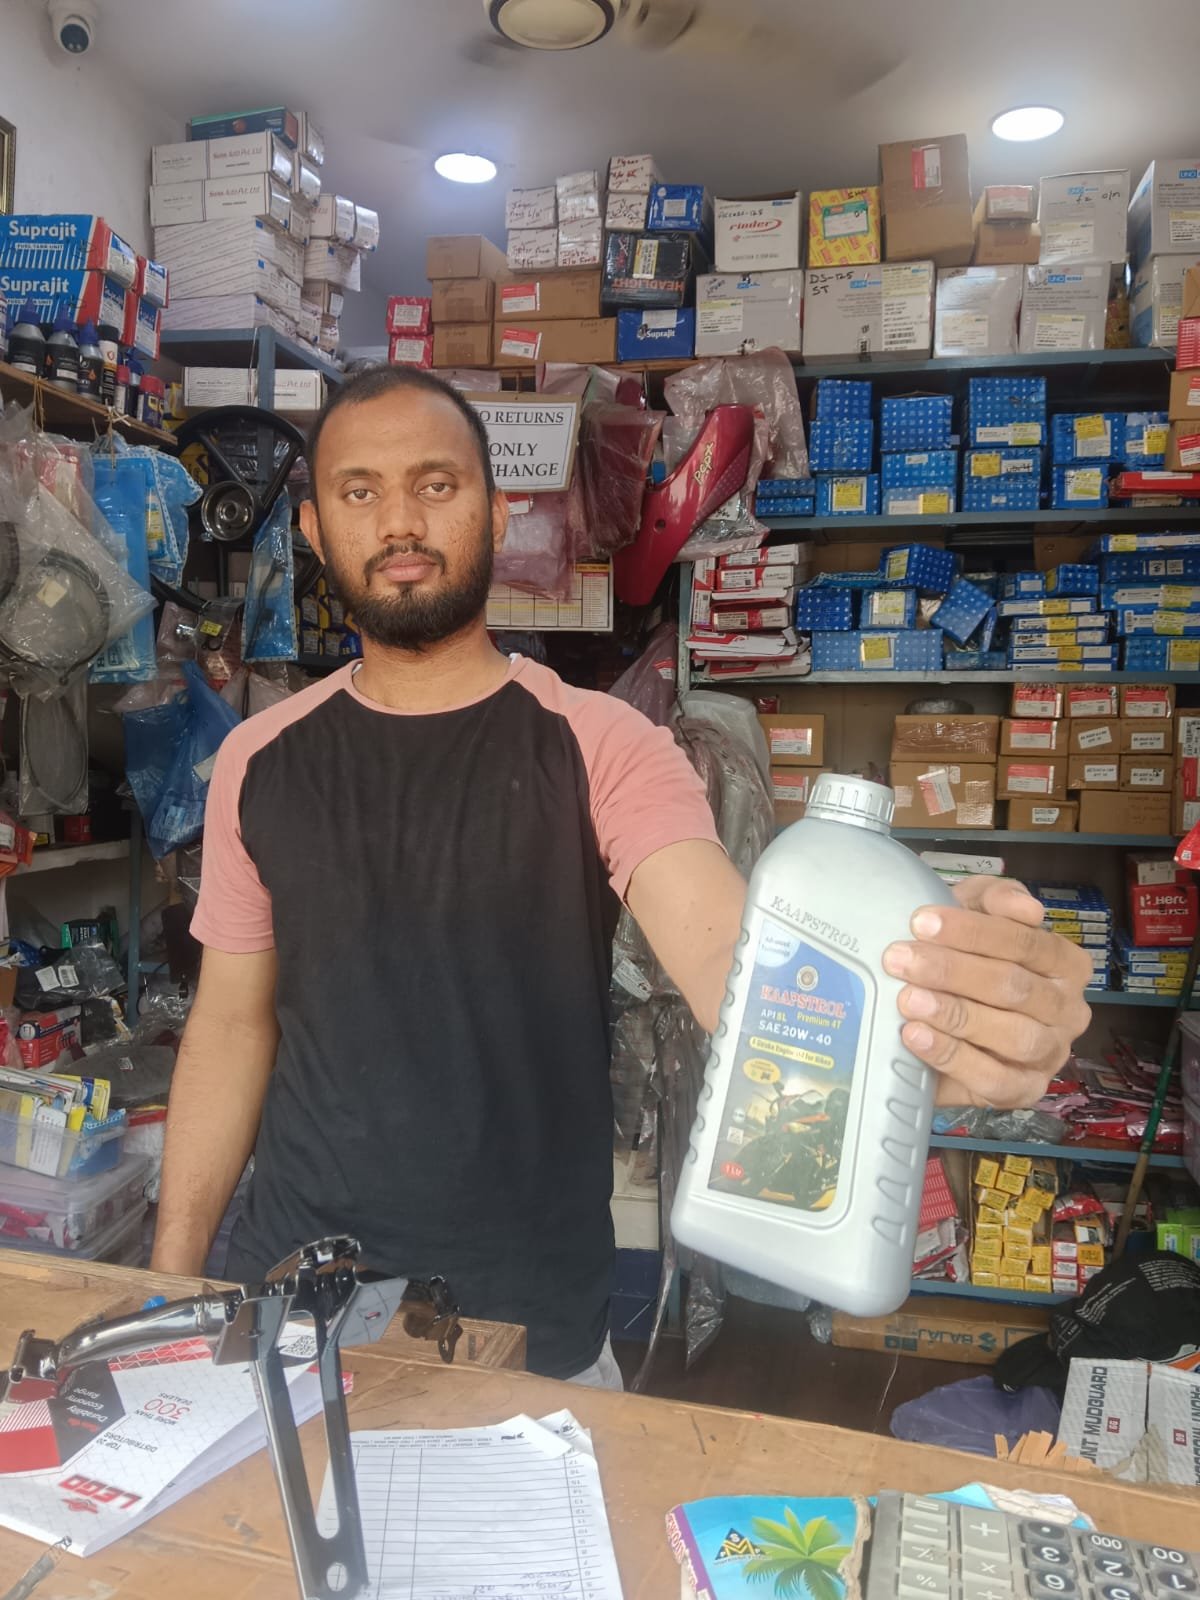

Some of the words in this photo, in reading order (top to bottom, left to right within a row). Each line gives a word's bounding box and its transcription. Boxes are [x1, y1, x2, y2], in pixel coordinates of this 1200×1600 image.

[8, 219, 77, 240] Suprajit
[0, 275, 70, 296] Suprajit
[611, 278, 685, 292] HEADLIGHT
[646, 329, 676, 340] Suprajit
[479, 410, 491, 422] O
[495, 411, 564, 424] RETURNS
[489, 442, 538, 457] ONLY
[491, 462, 559, 478] HANGE
[769, 895, 860, 953] KAAPSTROL
[760, 984, 847, 1020] KAAPSTROL
[760, 1008, 776, 1018] API
[797, 1012, 830, 1028] Premium
[831, 1020, 843, 1030] 4T
[759, 1020, 781, 1034] SAE
[782, 1025, 809, 1041] 20W
[815, 1033, 832, 1046] 40
[73, 1387, 101, 1400] Range
[1083, 1366, 1108, 1436] MUDGUARD
[65, 1394, 105, 1411] Economy
[143, 1398, 191, 1420] 300
[66, 1404, 109, 1423] Durability
[103, 1431, 158, 1453] DISTRIBUTORS
[106, 1440, 122, 1451] TOP
[57, 1474, 143, 1510] LEGO
[1090, 1534, 1123, 1550] 000
[1040, 1546, 1061, 1563] 3
[1152, 1547, 1185, 1564] 00
[1102, 1560, 1125, 1577] 2
[1044, 1574, 1066, 1591] 6
[1170, 1574, 1187, 1590] 1
